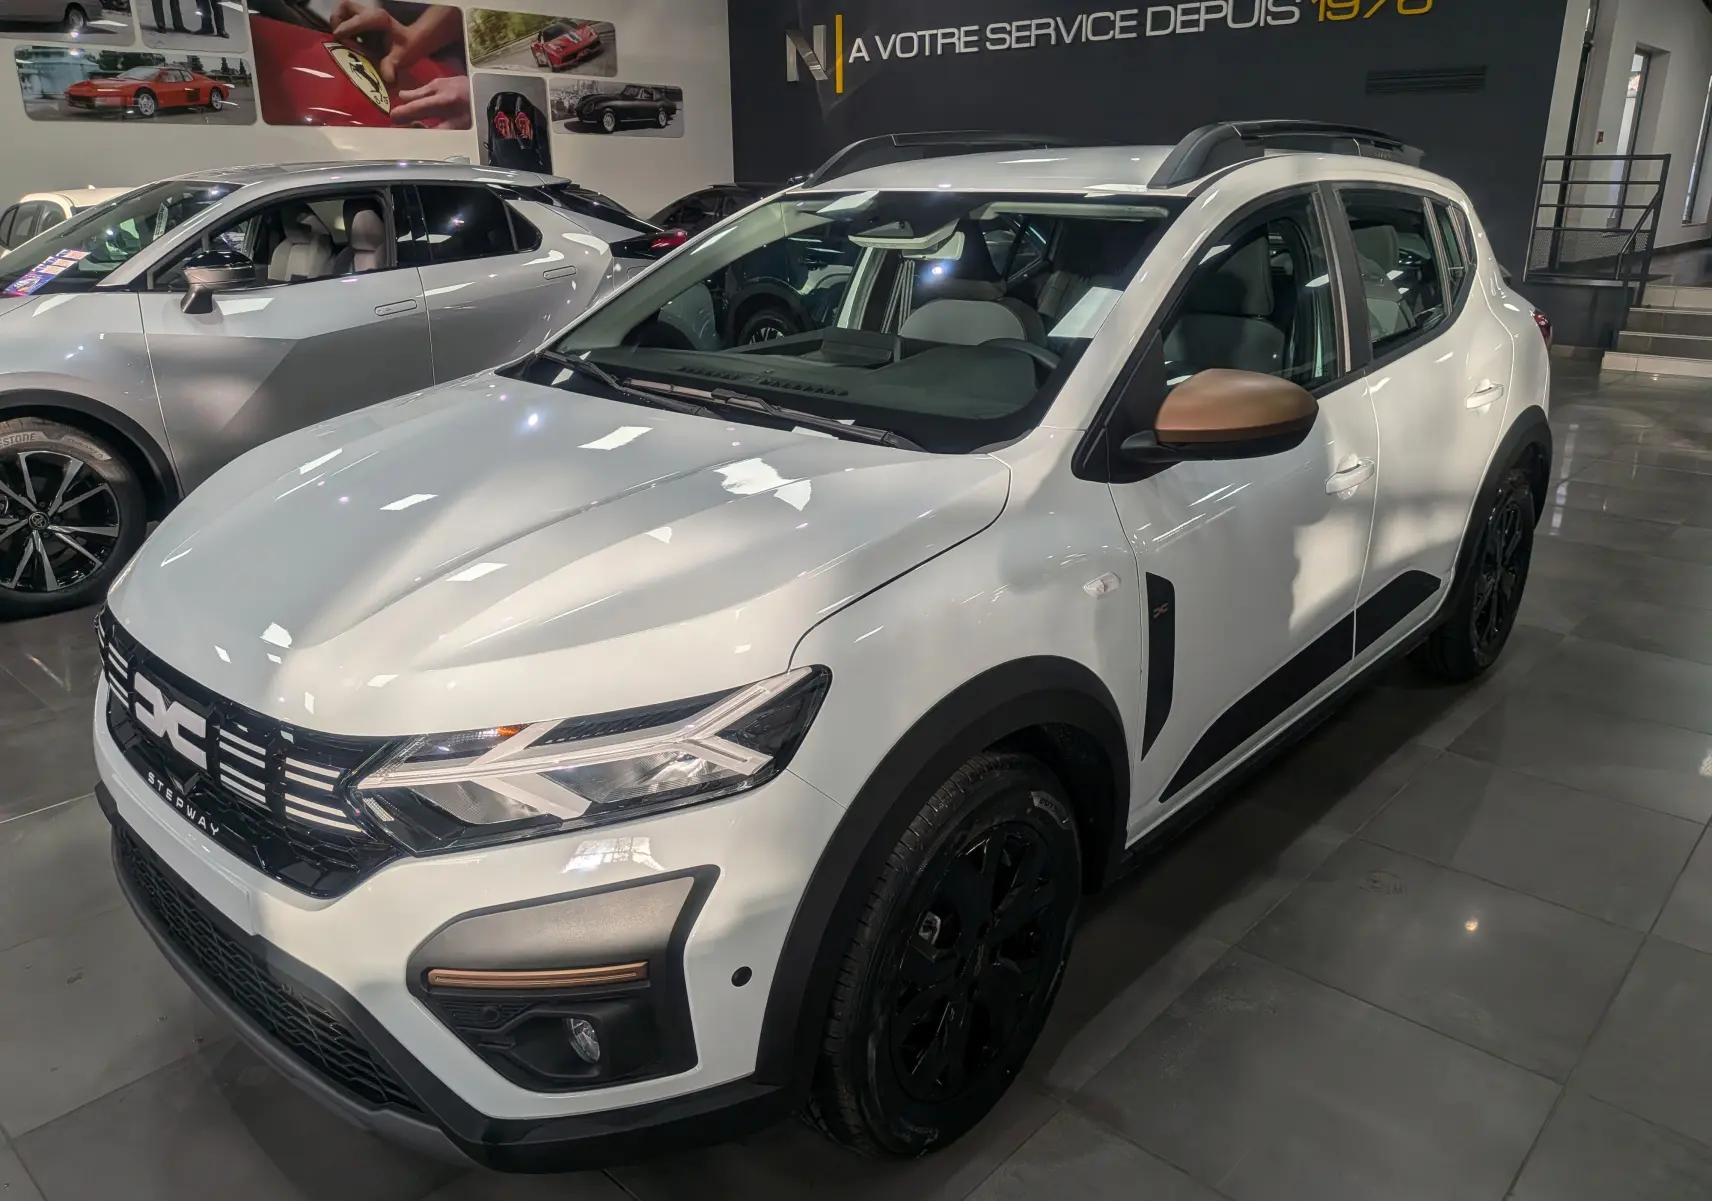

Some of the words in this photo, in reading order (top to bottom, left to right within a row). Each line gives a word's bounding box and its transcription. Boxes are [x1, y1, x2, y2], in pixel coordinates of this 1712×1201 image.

[848, 37, 871, 63] A
[875, 25, 979, 61] VOTRE
[985, 9, 1139, 51] SERVICE
[1145, 0, 1301, 36] DEPUIS
[0, 432, 36, 449] STONE
[147, 771, 219, 836] STEPWAY
